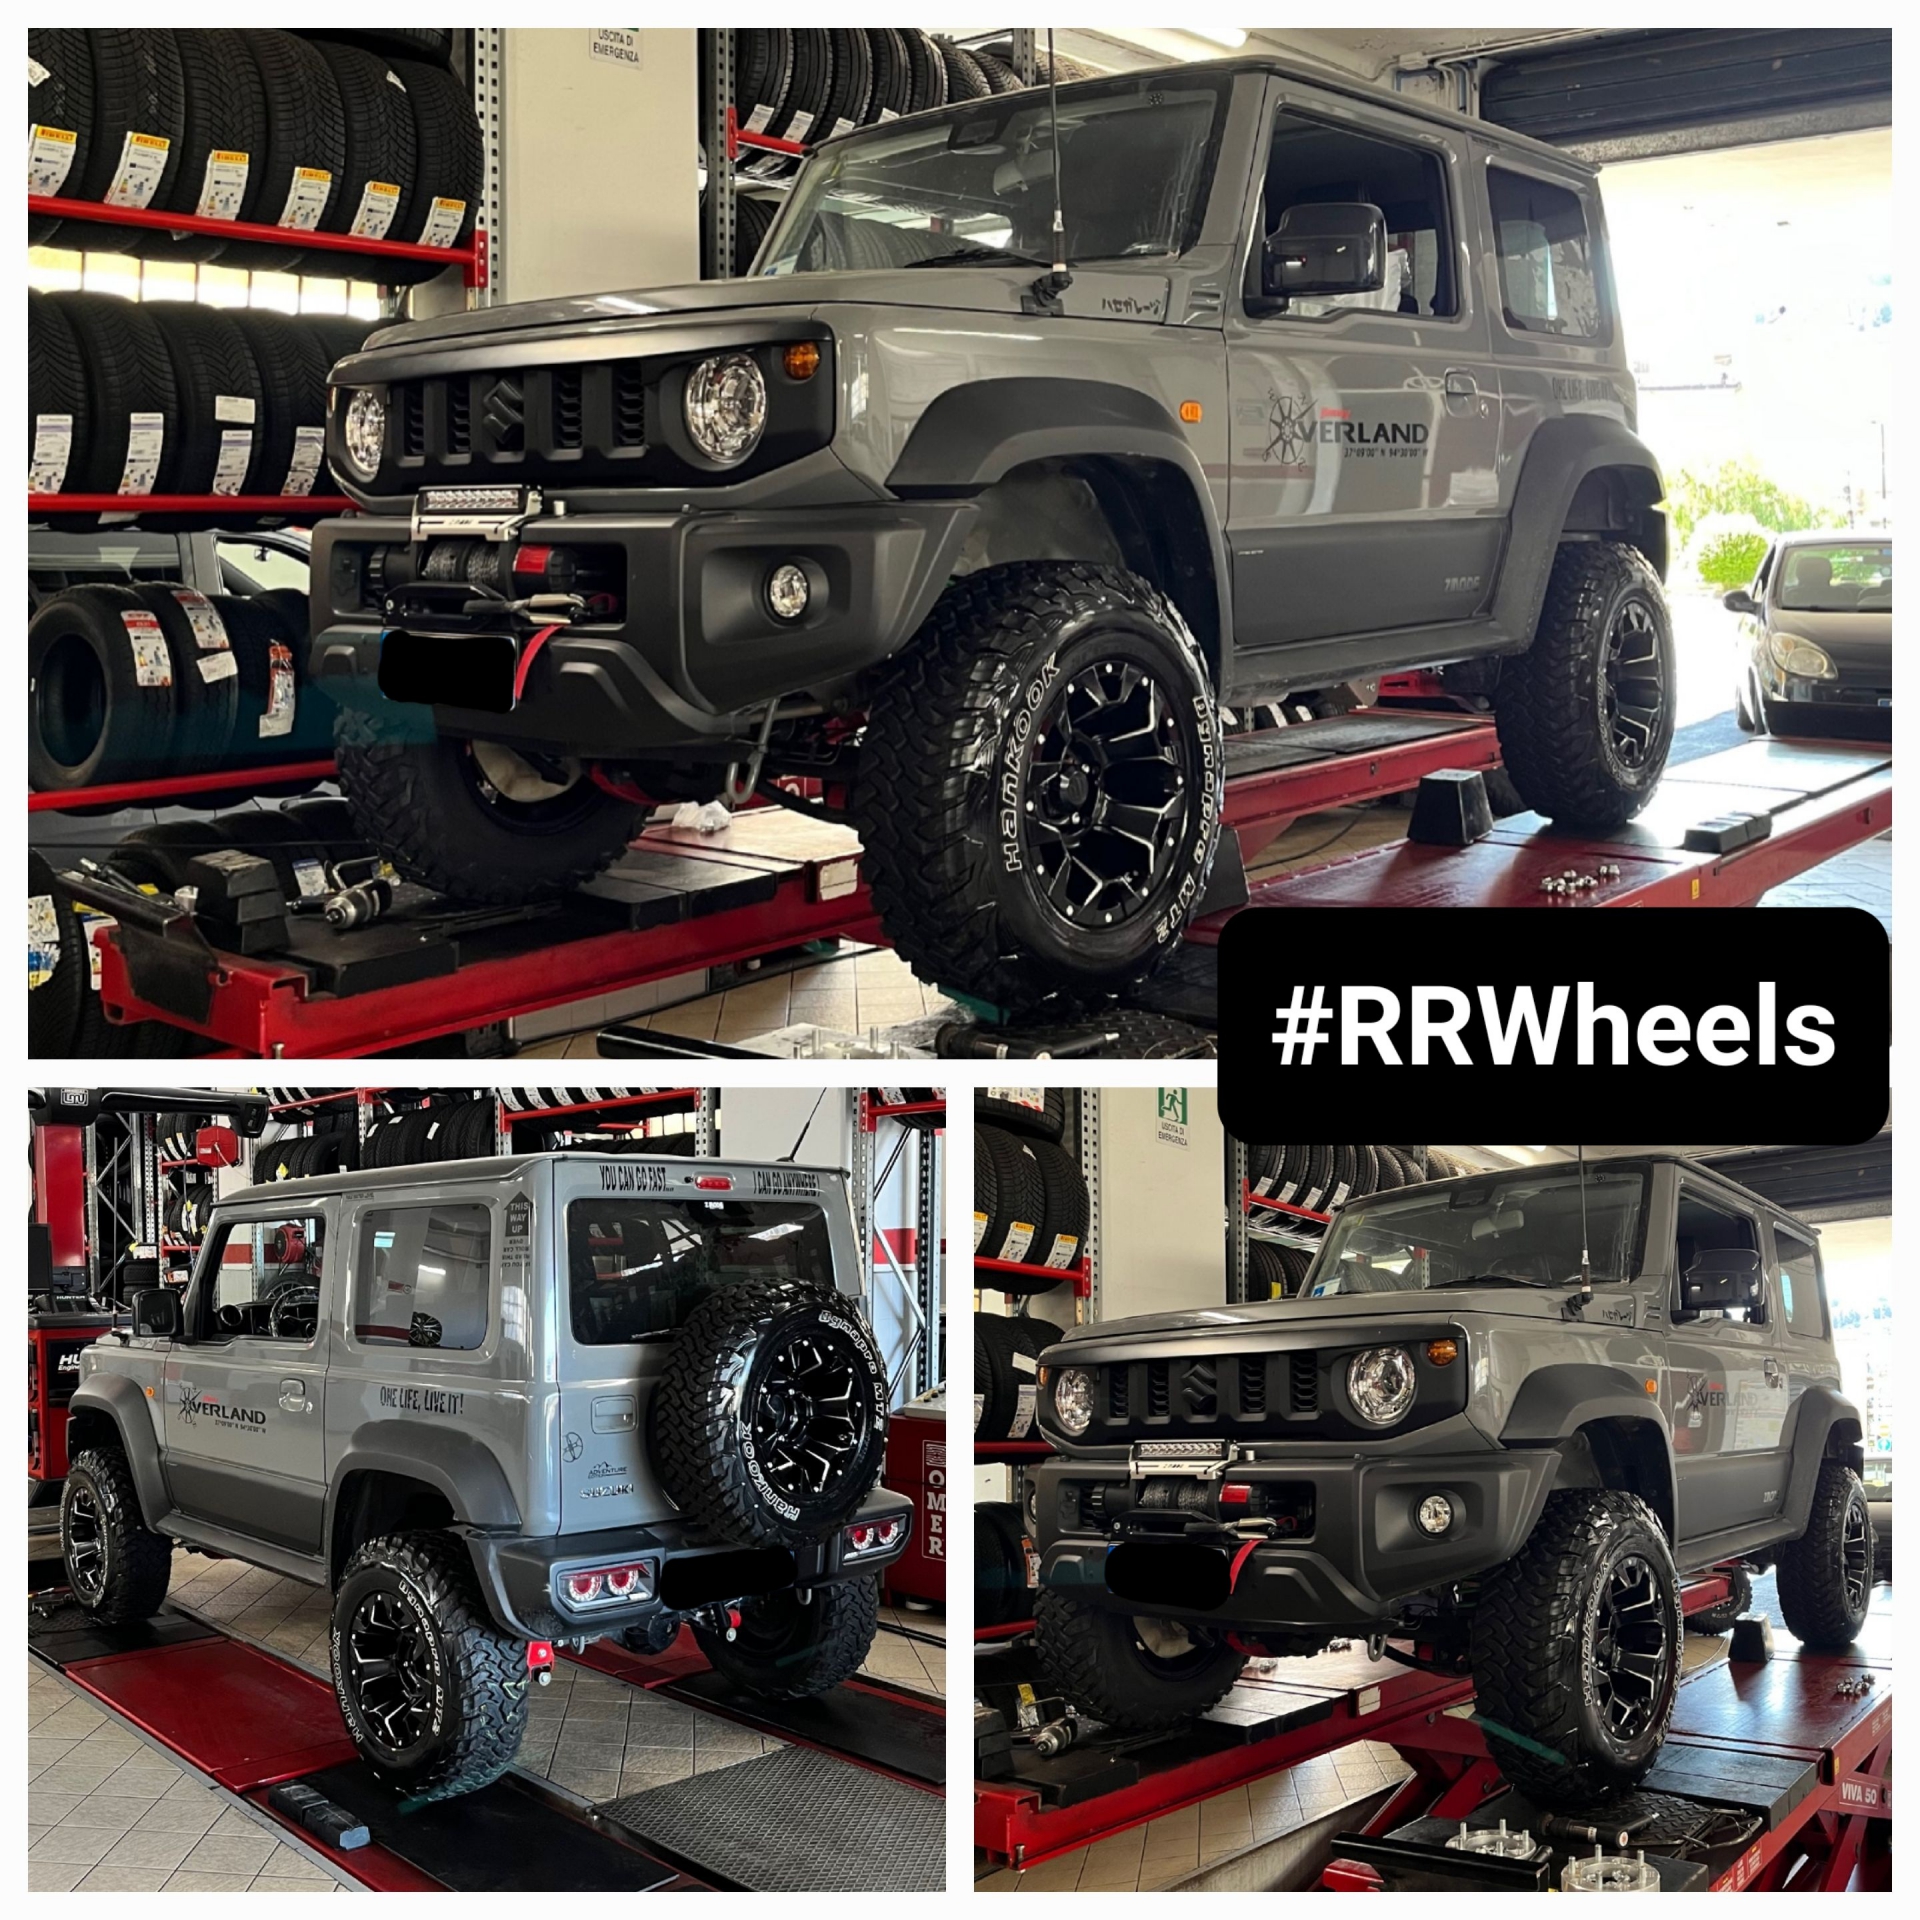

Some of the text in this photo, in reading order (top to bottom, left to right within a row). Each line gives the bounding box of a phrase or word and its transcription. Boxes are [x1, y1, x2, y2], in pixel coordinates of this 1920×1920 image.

[626, 34, 634, 46] DI
[593, 42, 640, 63] EMERGENZA
[599, 1165, 617, 1191] YOU
[617, 1165, 635, 1191] CAN
[635, 1166, 648, 1191] GO
[752, 1170, 757, 1195] I
[757, 1171, 772, 1195] CAN
[771, 1172, 782, 1196] GO
[510, 1202, 529, 1211] THIS
[510, 1213, 527, 1222] WAY
[511, 1225, 523, 1233] UP
[59, 1353, 81, 1365] HU
[380, 1386, 464, 1414] ONE LIFE, LIVE IT!
[589, 1466, 628, 1475] ADVENTURE
[579, 1483, 634, 1500] SUZUKI
[926, 1469, 946, 1556] OMER
[1841, 1781, 1877, 1805] VIVA 50
